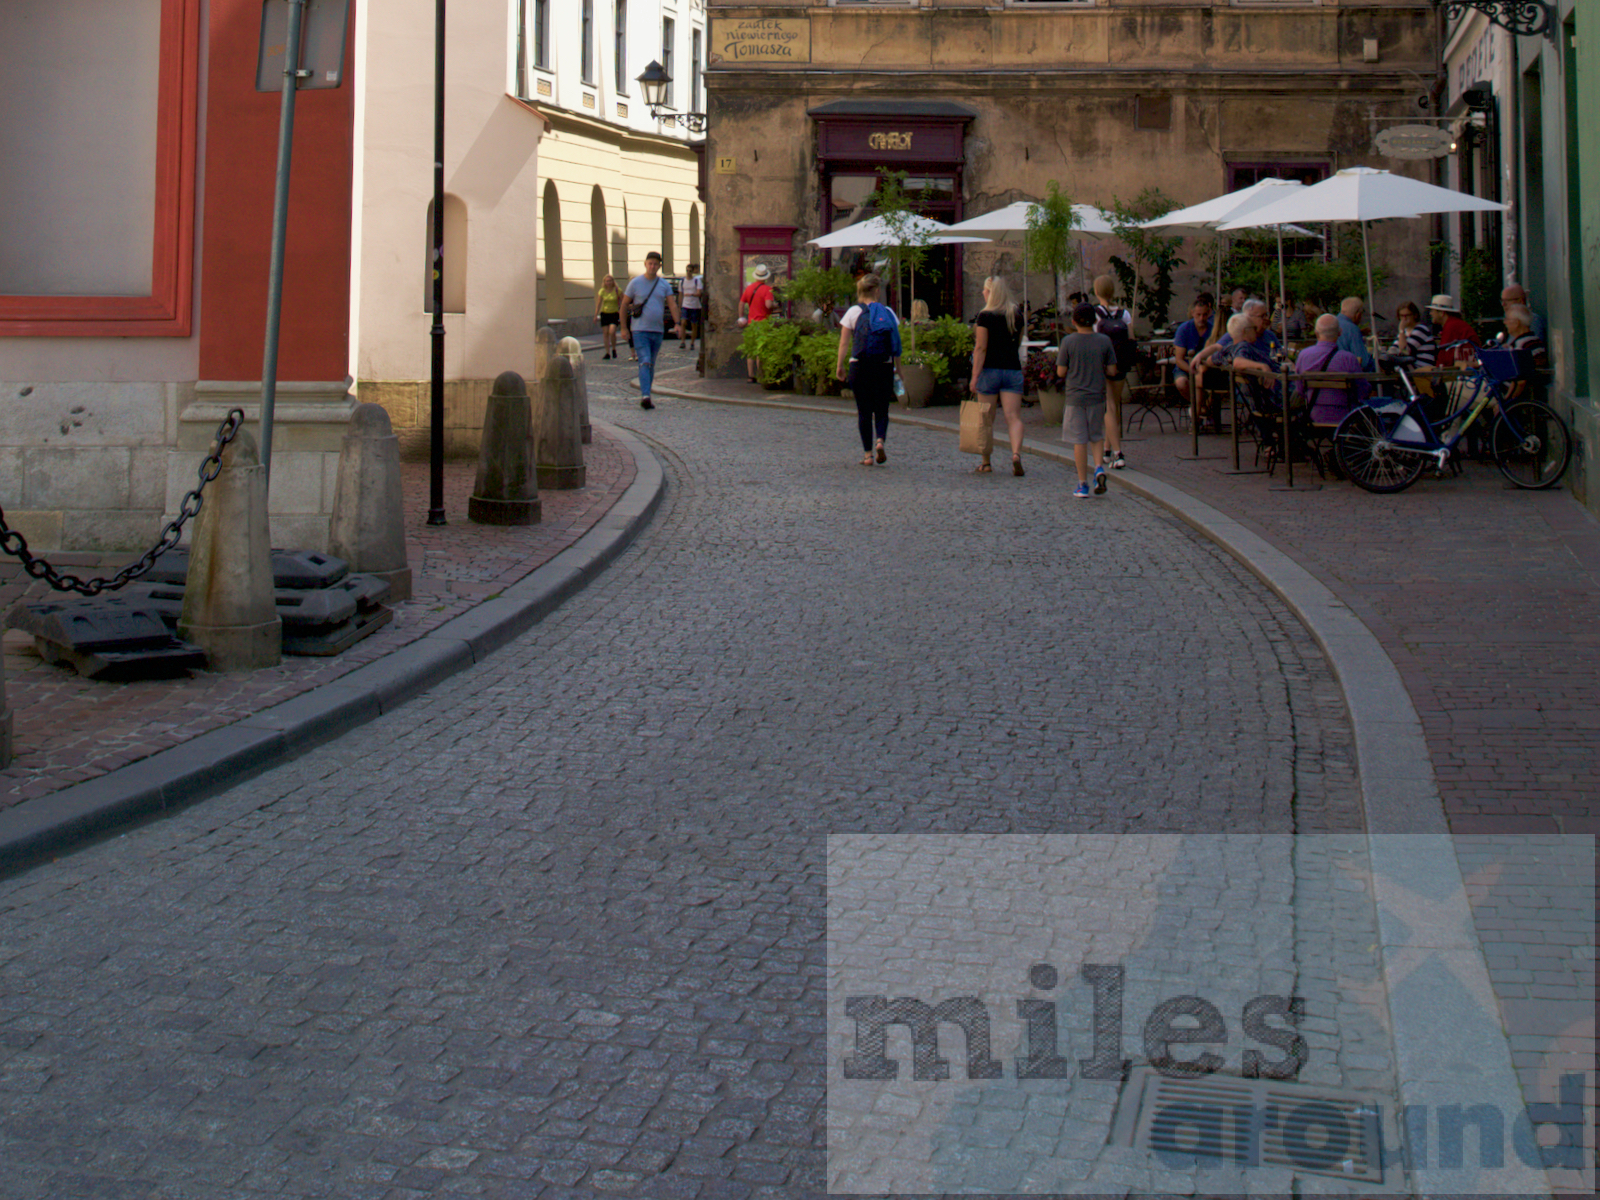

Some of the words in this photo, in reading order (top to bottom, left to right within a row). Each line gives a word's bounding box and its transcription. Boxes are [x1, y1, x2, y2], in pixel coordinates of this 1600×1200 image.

[738, 19, 783, 31] zaułek
[725, 29, 799, 44] niewiernego
[724, 41, 792, 60] Tomasza
[720, 158, 732, 168] 17
